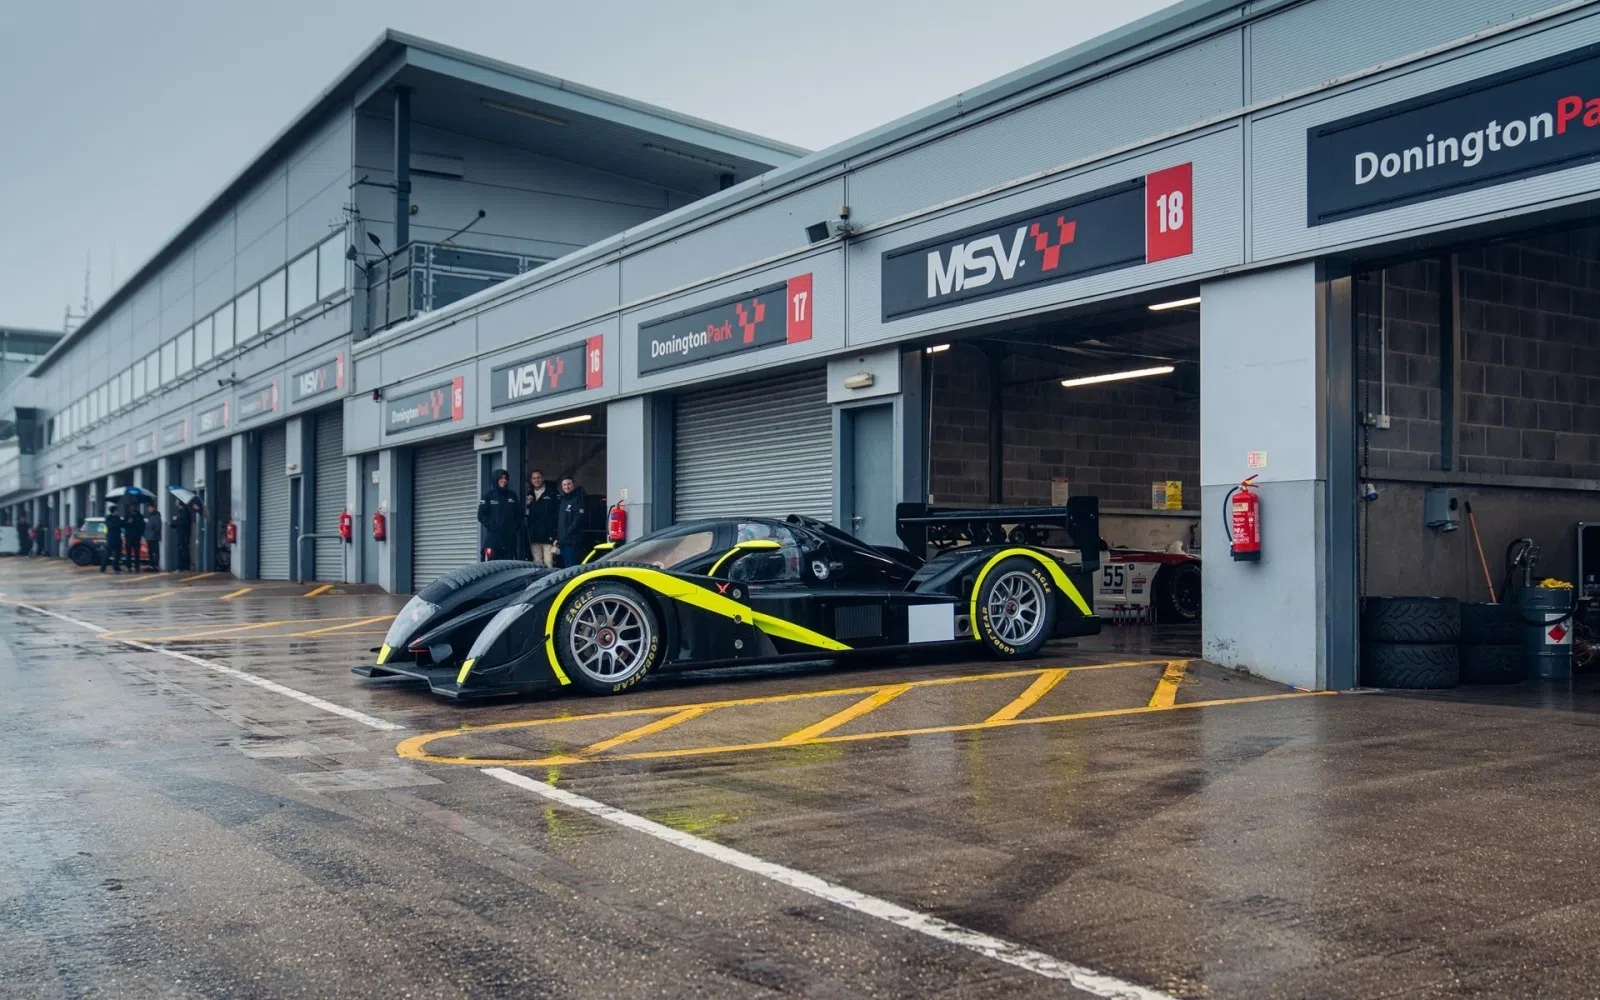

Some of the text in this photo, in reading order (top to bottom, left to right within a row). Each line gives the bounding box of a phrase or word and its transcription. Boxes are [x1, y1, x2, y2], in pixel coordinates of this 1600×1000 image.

[1156, 190, 1184, 233] 18
[927, 226, 1028, 298] MSV
[793, 291, 808, 323] 17
[651, 319, 733, 359] DoningtonPark
[508, 360, 547, 399] MSV
[590, 348, 600, 373] 16
[1031, 568, 1052, 594] EAGLE
[1103, 565, 1124, 588] 55
[565, 590, 594, 624] EAGLE
[982, 606, 1015, 655] GOODYEAR
[612, 635, 659, 692] GOODYEAR
